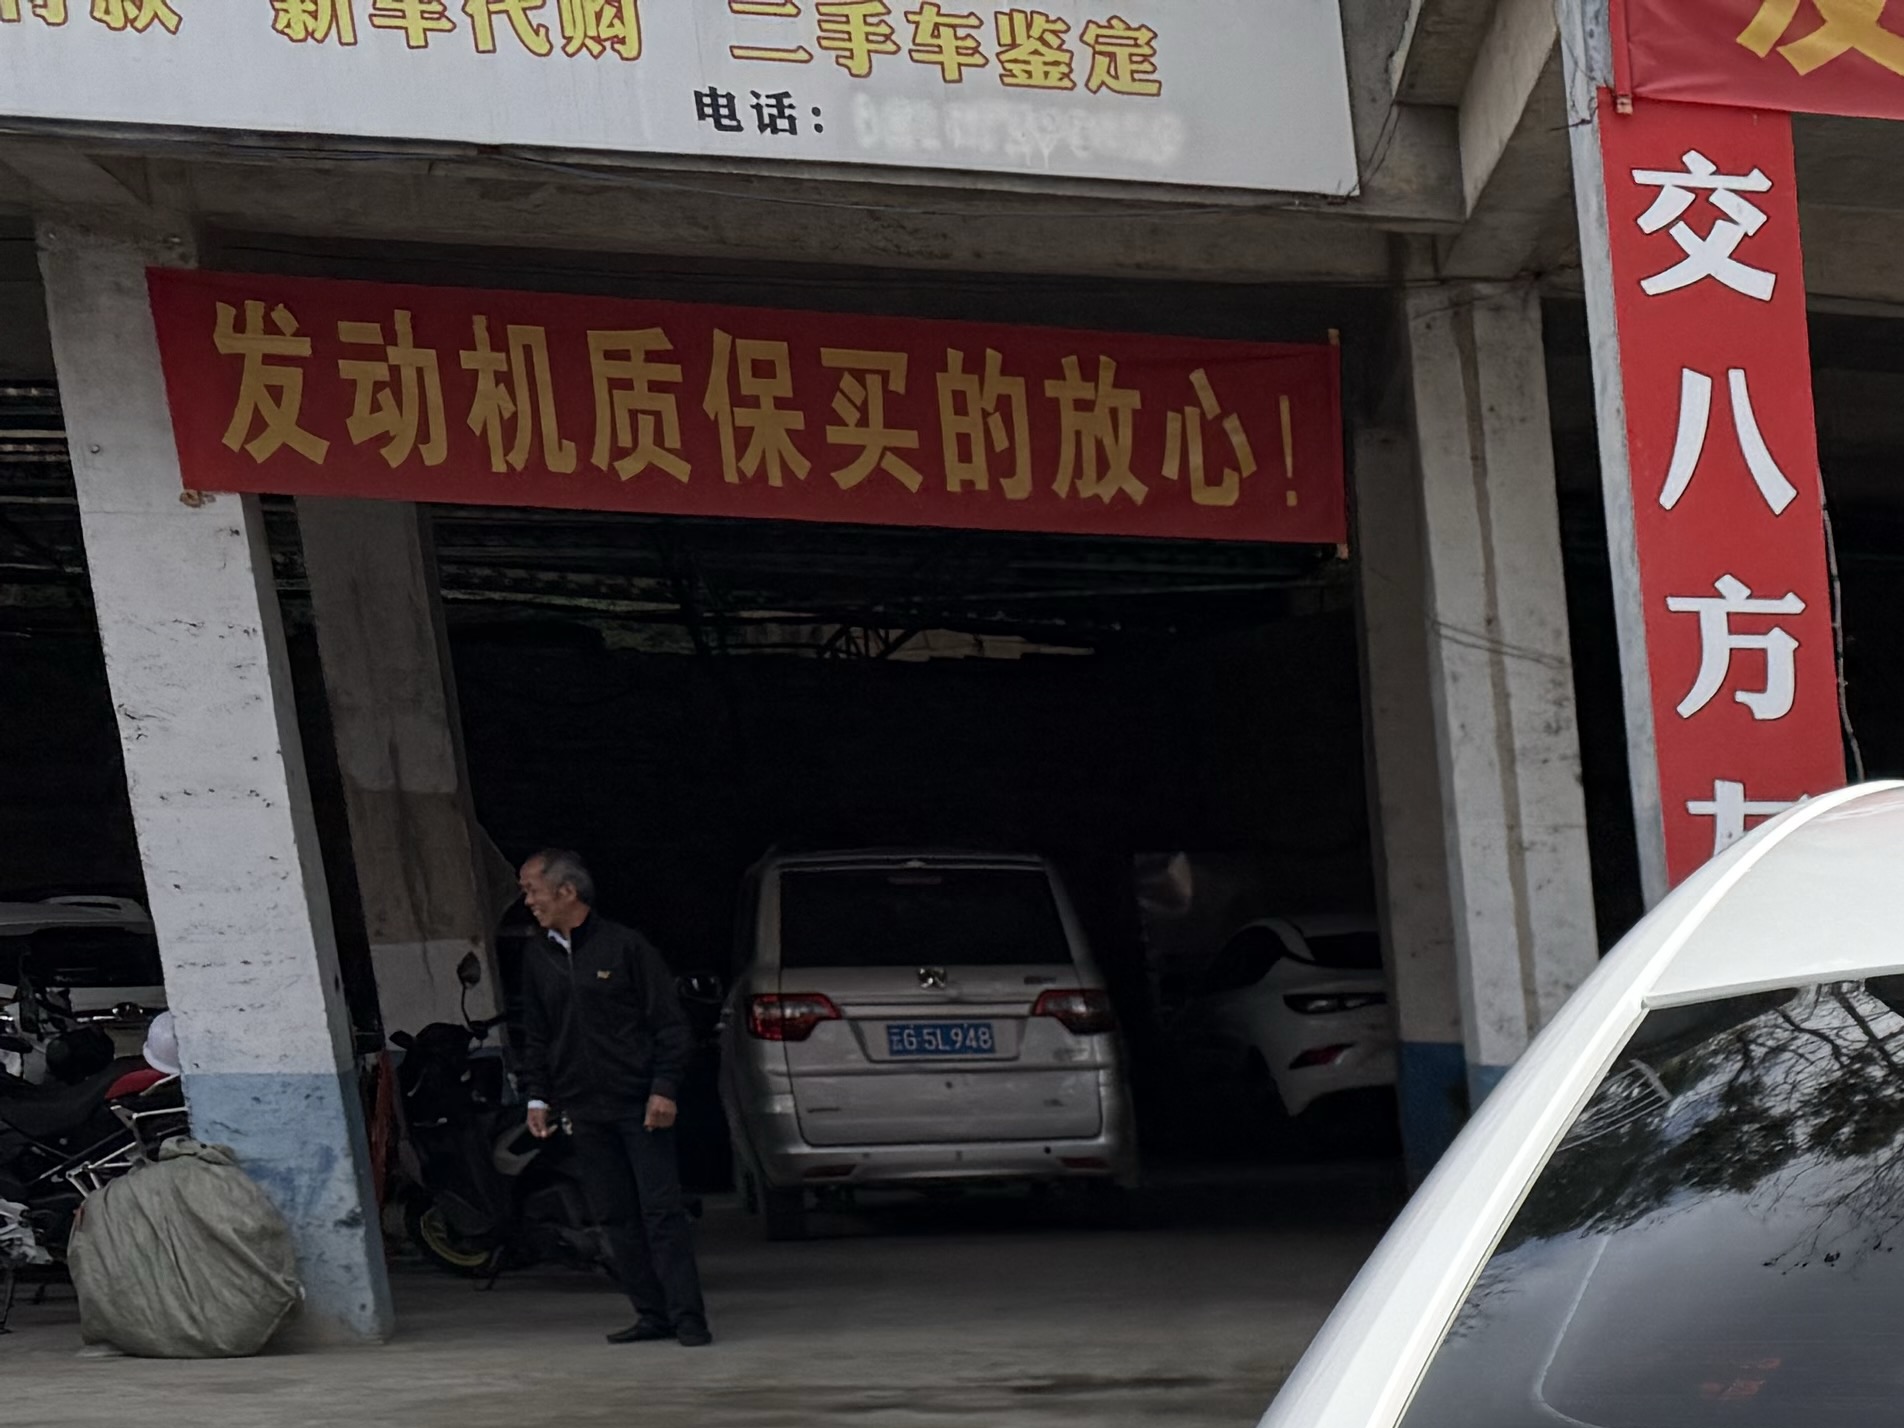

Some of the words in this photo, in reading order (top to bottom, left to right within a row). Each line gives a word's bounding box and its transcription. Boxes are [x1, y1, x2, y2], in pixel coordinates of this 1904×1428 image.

[271, 0, 642, 61] 新车代购
[729, 0, 1163, 97] 二手车鉴定
